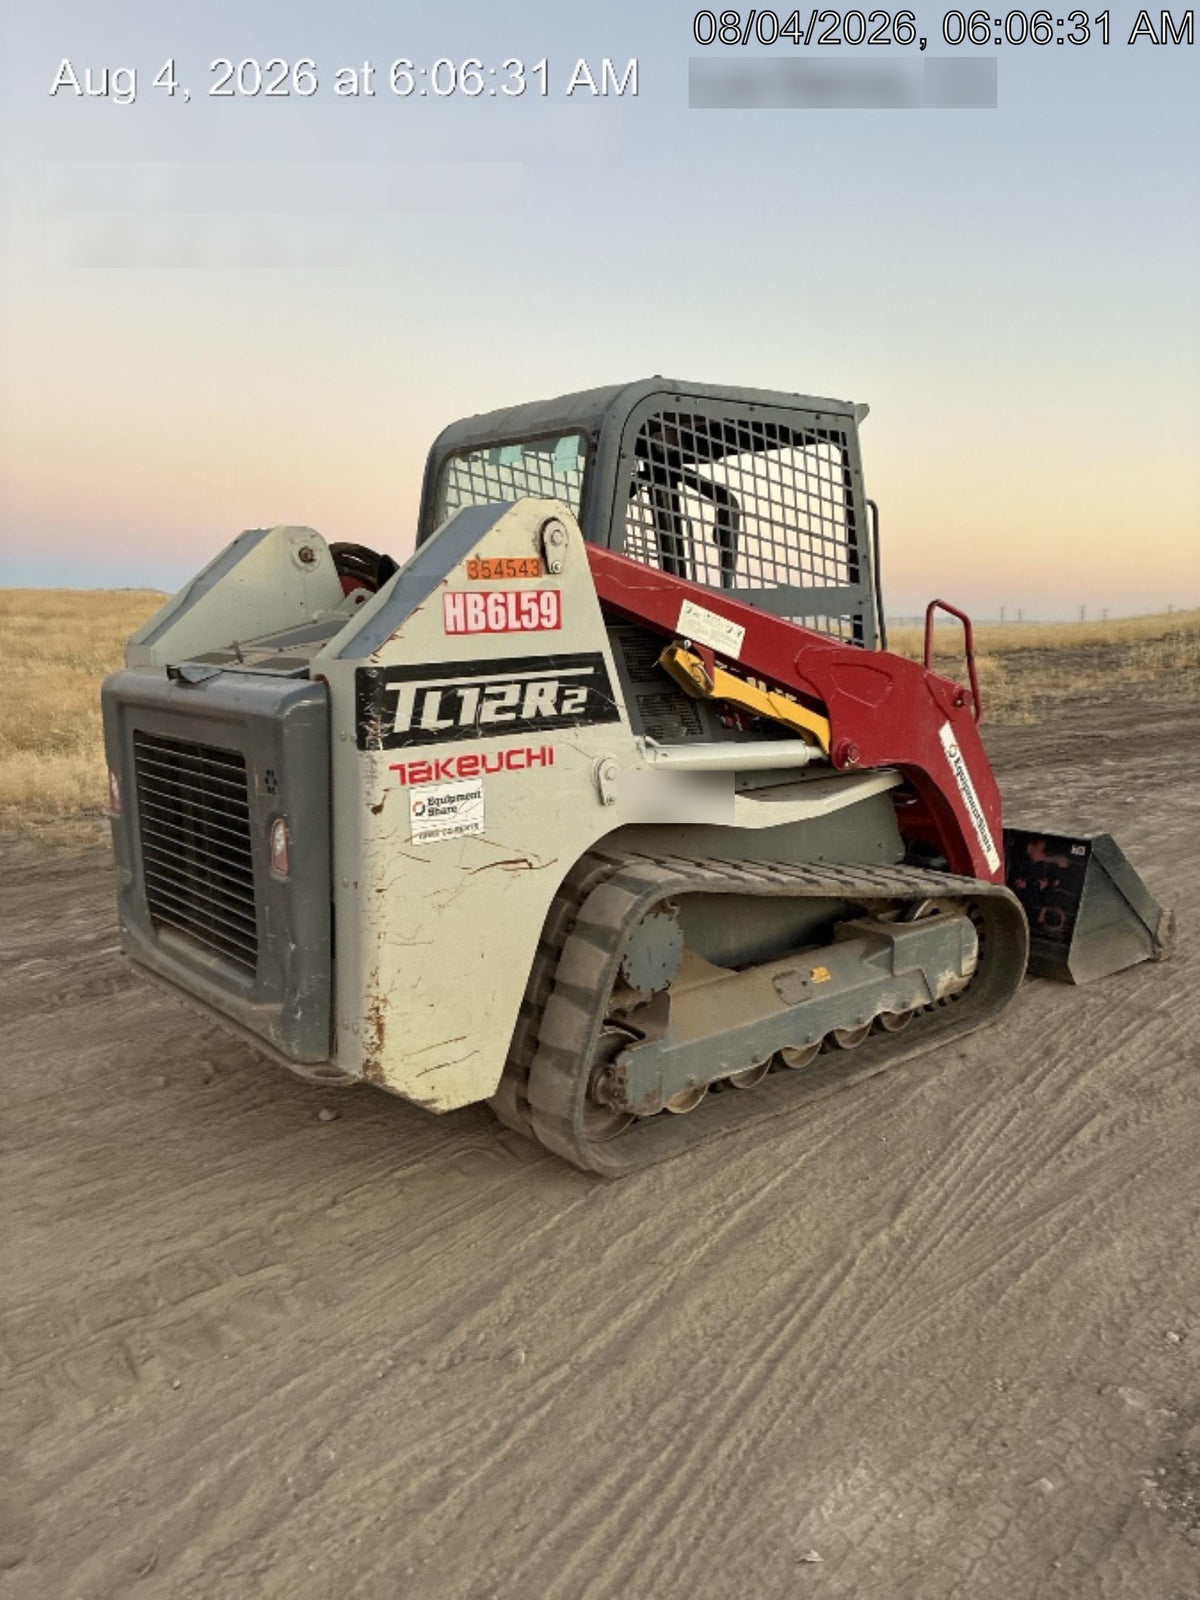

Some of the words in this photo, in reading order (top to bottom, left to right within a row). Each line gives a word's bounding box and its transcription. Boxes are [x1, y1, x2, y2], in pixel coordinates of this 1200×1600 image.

[468, 559, 542, 580] 354543
[445, 591, 558, 632] HB6L59
[427, 790, 482, 806] Equipment
[427, 806, 458, 817] Share
